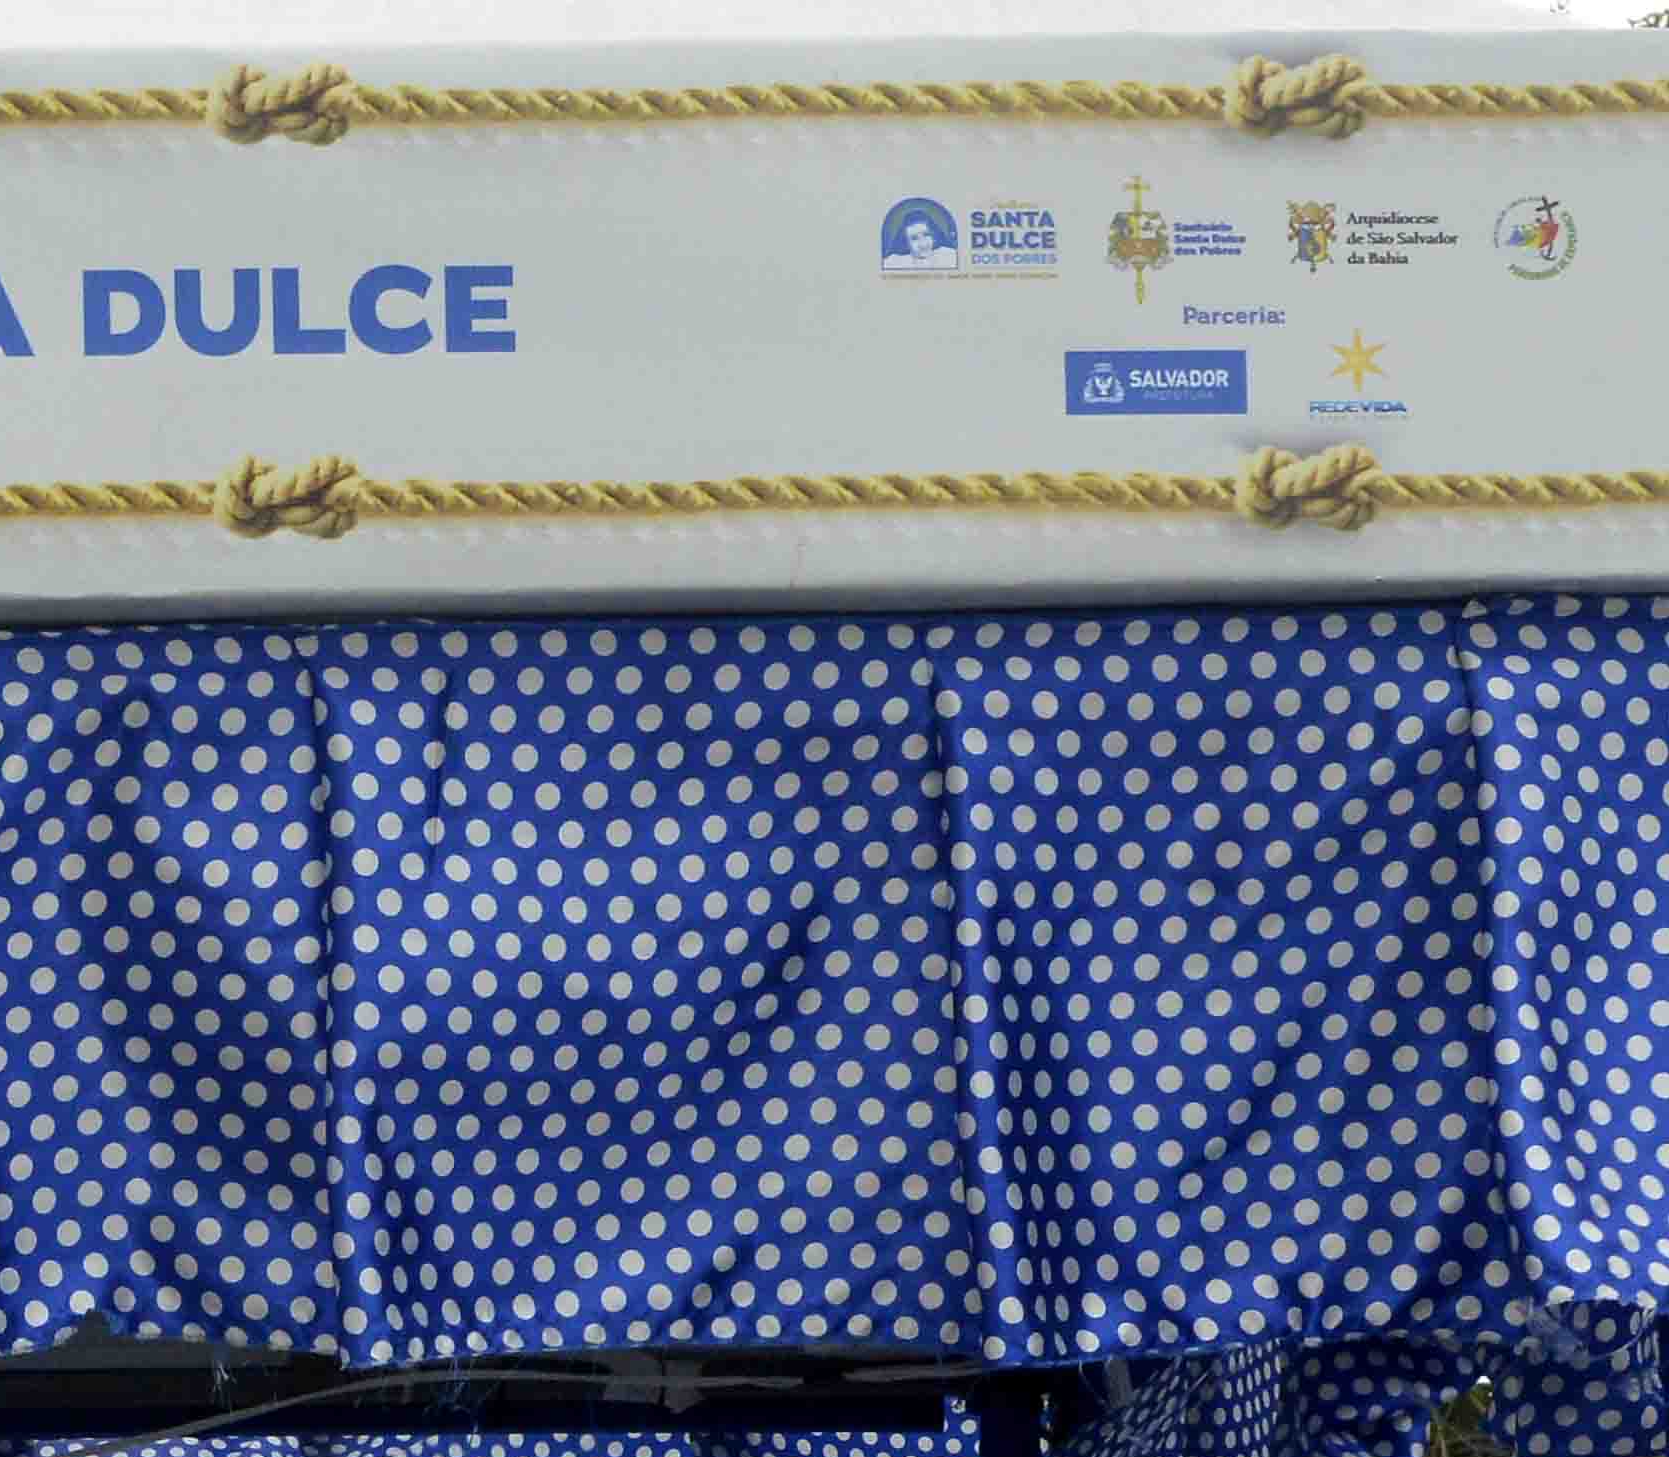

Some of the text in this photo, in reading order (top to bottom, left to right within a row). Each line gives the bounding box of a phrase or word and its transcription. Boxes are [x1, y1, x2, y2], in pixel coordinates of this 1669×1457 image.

[970, 210, 1055, 228] SANTA
[1346, 211, 1439, 229] Arquidiocese
[971, 231, 1056, 250] DULCE
[1346, 231, 1459, 245] de São Salvador
[1347, 251, 1409, 265] da Bahia
[84, 264, 518, 358] DULCE
[1182, 305, 1287, 326] Parceria:
[1129, 368, 1230, 388] SALVADOR
